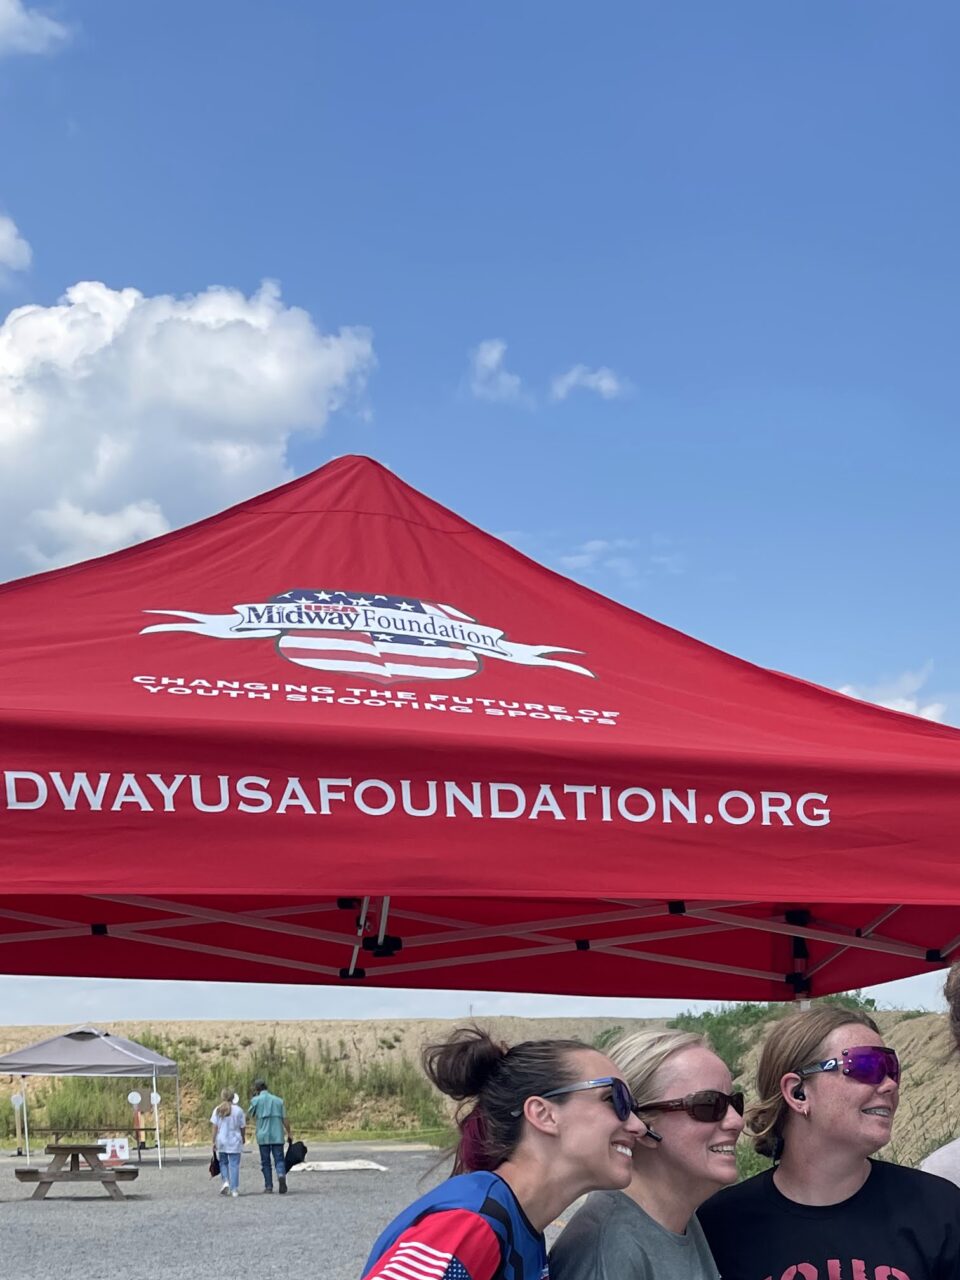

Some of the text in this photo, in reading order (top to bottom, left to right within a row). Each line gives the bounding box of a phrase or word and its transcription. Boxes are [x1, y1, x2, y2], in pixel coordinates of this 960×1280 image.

[132, 676, 620, 718] CHANGING THE FUTURE OF
[142, 685, 617, 725] YOUTH SHOOTING SPORTS
[3, 770, 831, 827] DWAYUSAFOUNDATION.ORG
